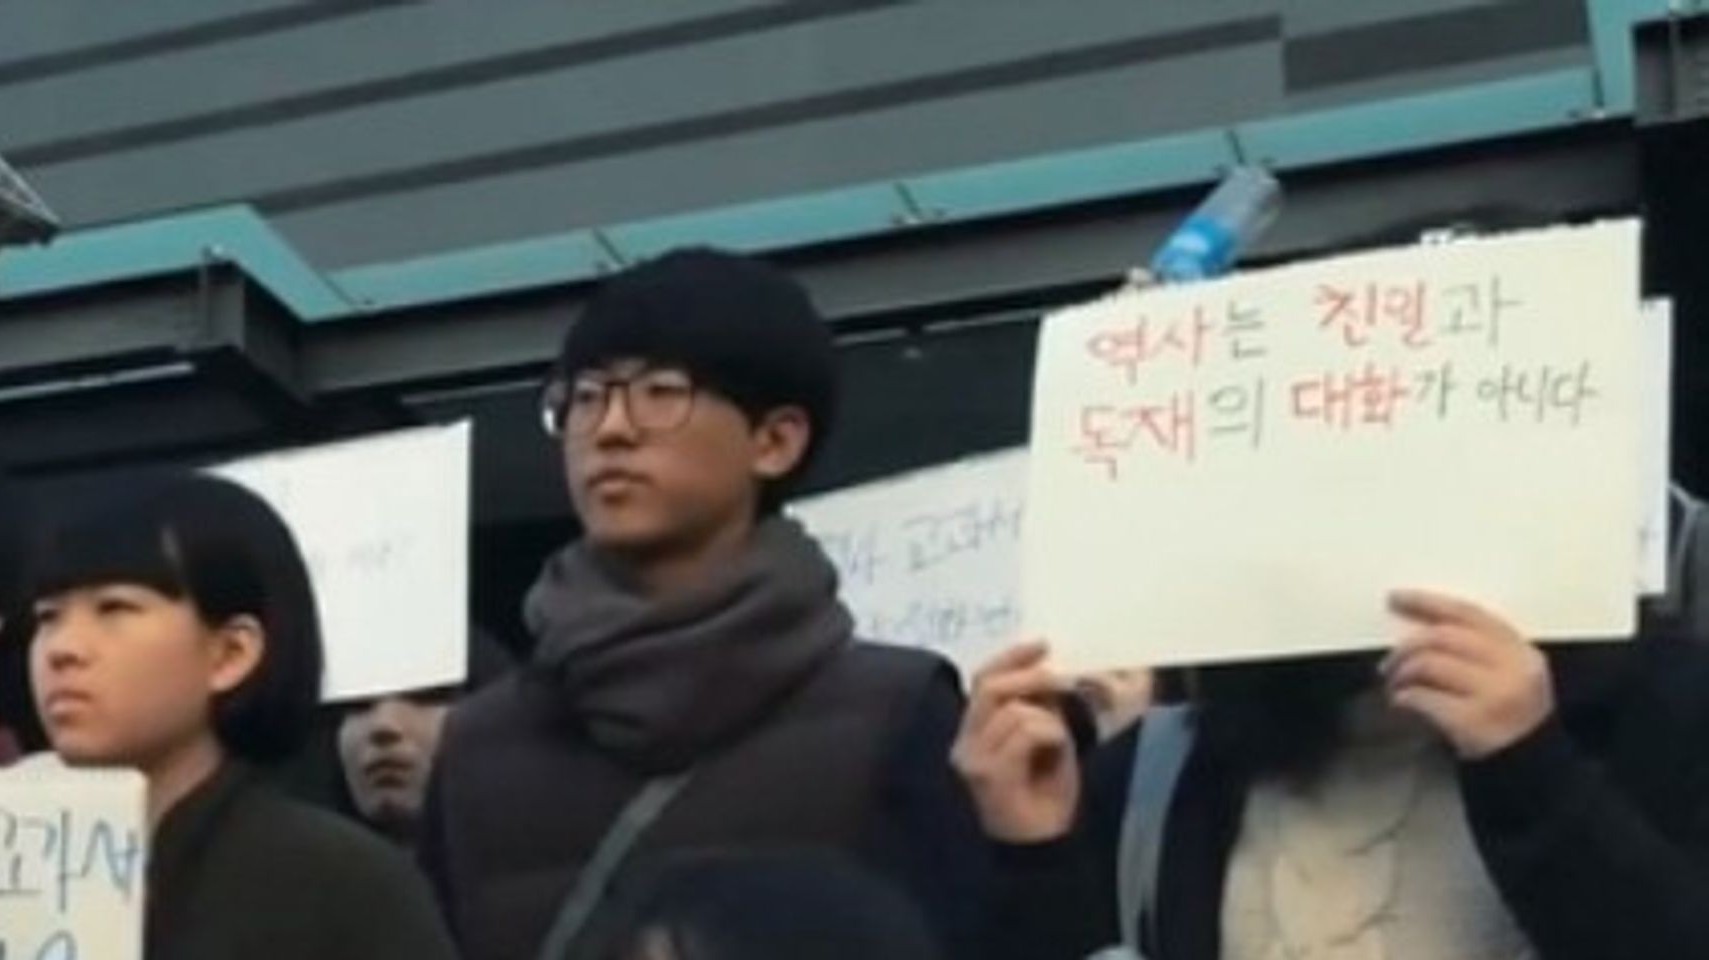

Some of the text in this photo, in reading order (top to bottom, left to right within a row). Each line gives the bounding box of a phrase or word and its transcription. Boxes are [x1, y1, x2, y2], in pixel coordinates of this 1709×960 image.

[1085, 276, 1523, 385] 역사는 친일과
[1071, 360, 1601, 481] 독재의 대화가 아니다
